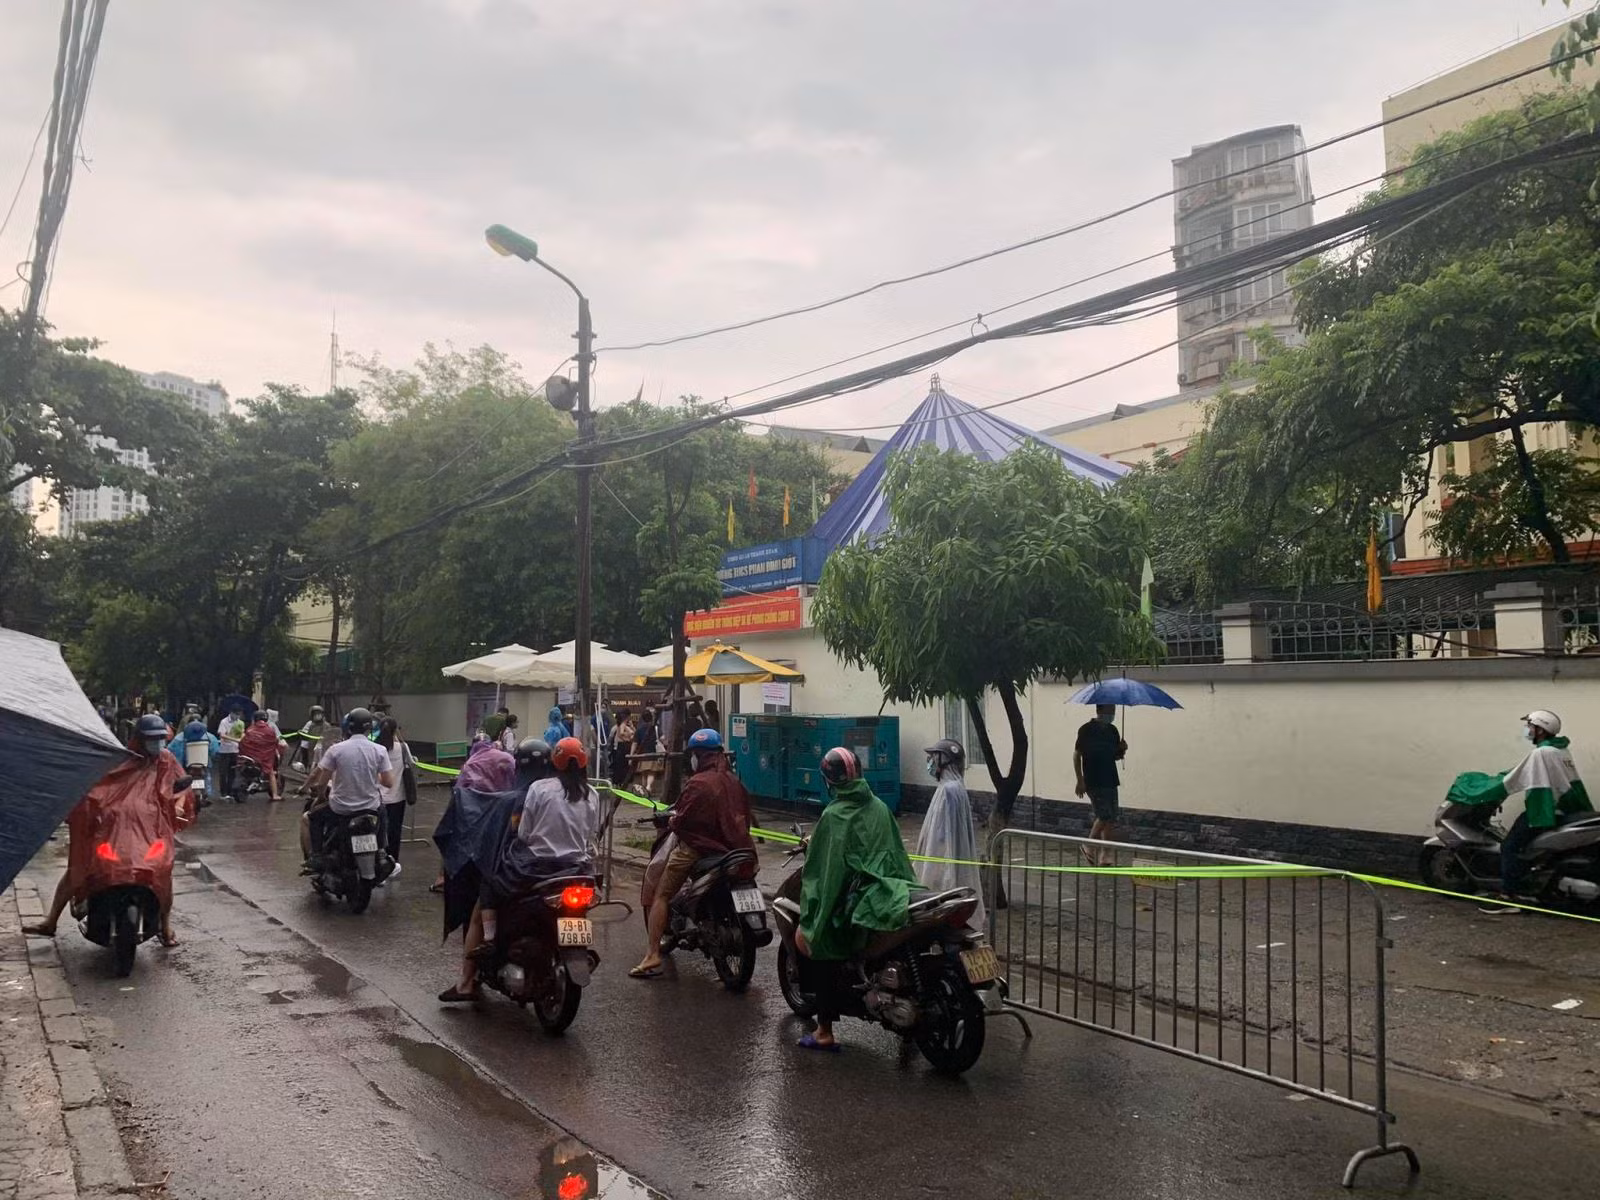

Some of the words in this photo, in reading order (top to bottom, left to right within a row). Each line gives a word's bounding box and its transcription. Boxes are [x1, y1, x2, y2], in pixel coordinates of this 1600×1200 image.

[739, 900, 762, 911] 2961
[562, 920, 588, 931] 29-B1
[560, 932, 592, 944] 798.66
